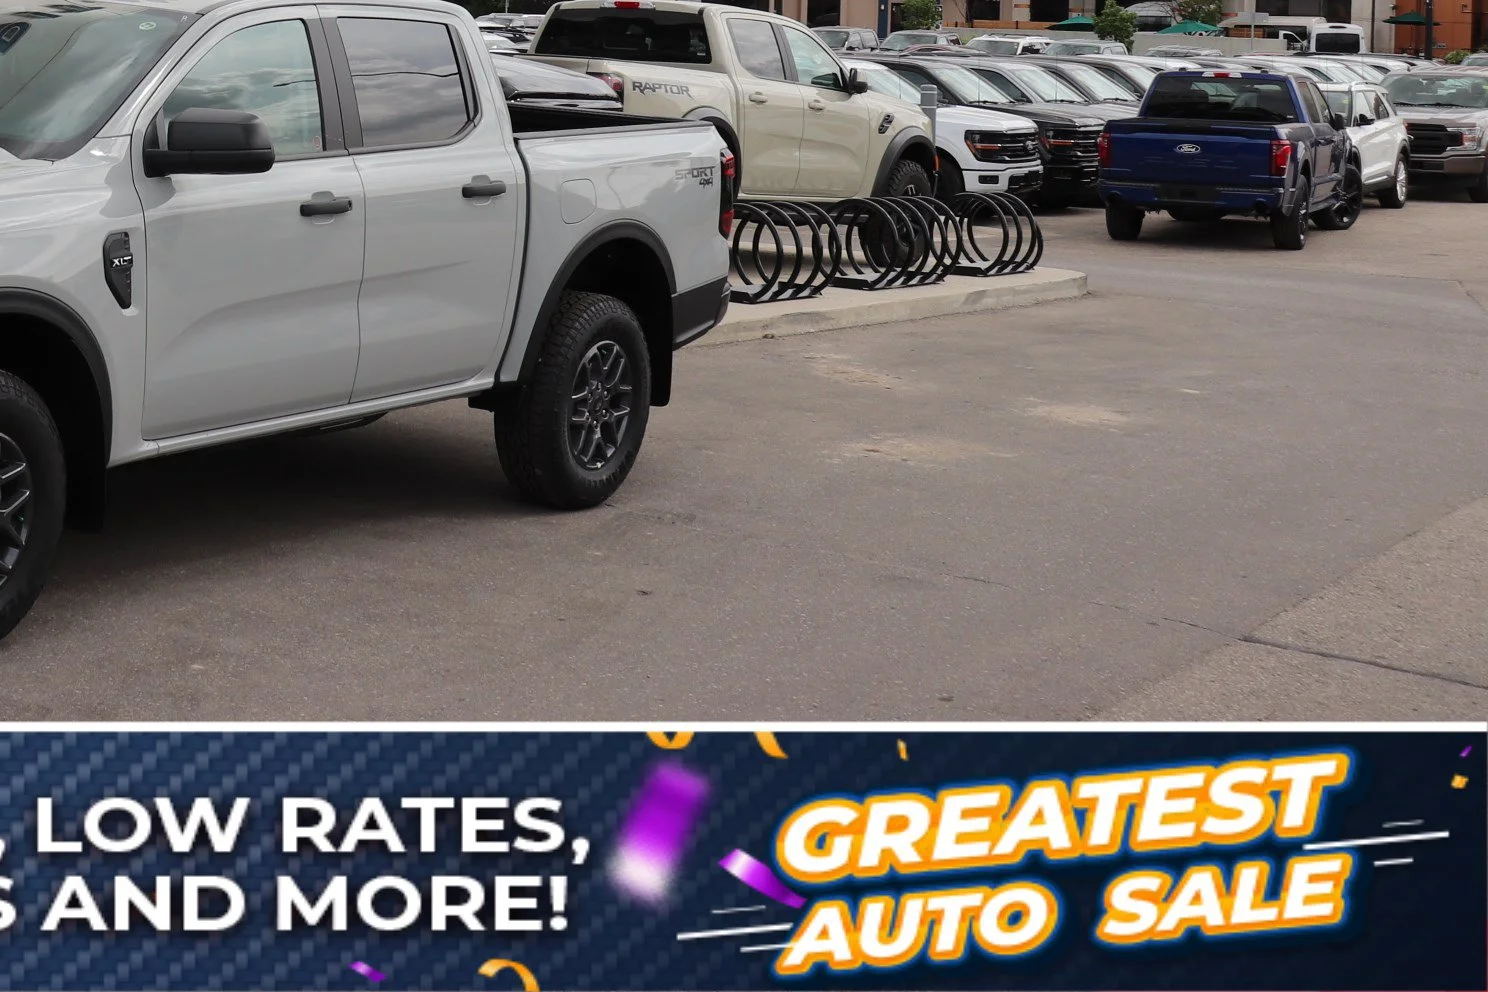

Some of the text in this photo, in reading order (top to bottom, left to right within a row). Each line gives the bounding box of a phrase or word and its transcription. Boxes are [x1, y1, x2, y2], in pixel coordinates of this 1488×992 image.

[632, 81, 694, 101] RAPTOR
[674, 166, 716, 180] SPORT
[112, 256, 132, 268] XLT
